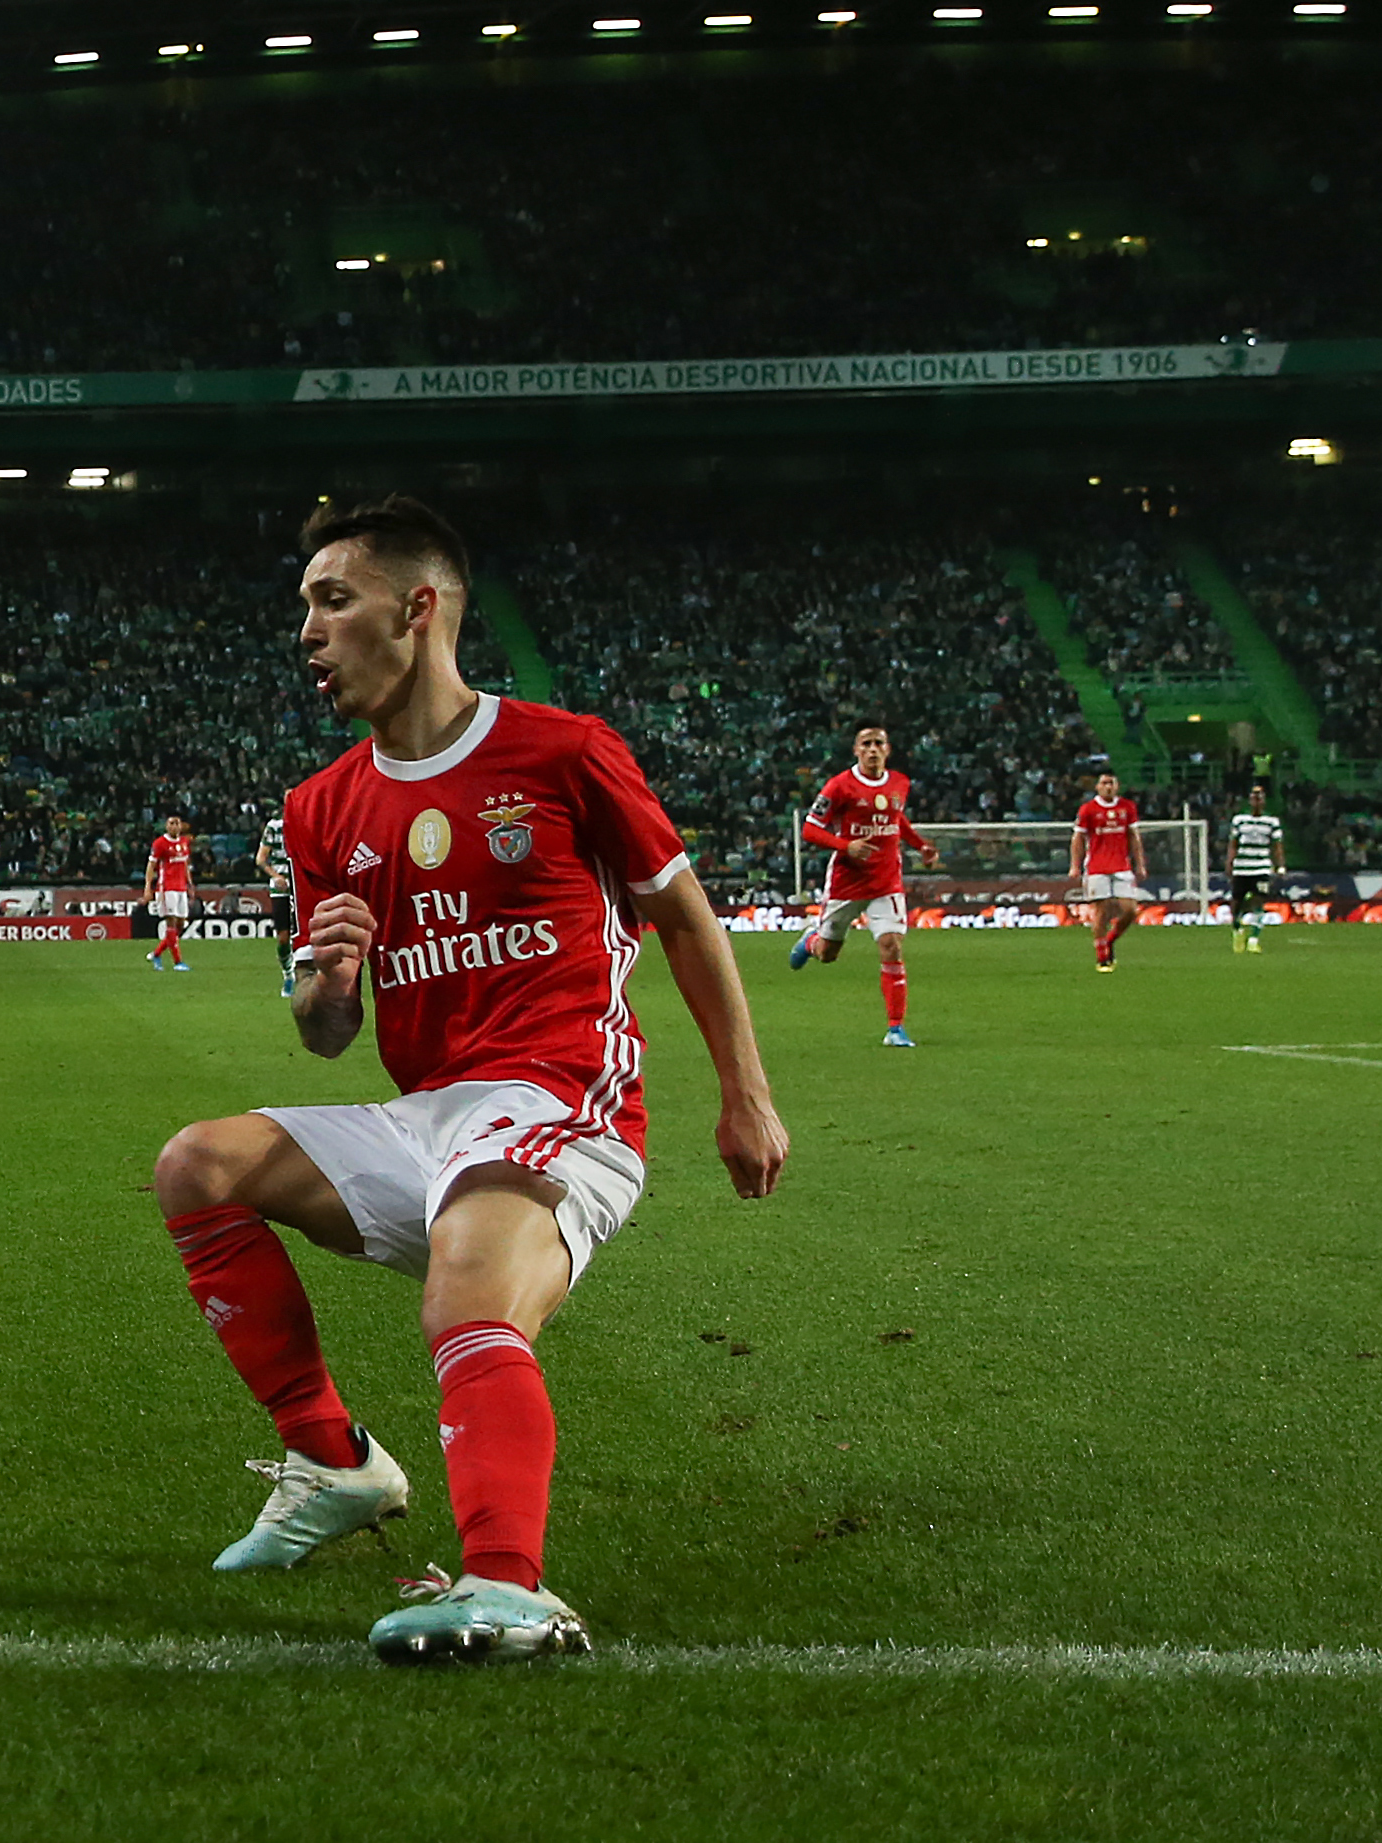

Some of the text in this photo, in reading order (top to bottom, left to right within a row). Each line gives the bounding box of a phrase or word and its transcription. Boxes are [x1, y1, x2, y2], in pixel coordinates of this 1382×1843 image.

[393, 351, 1177, 394] A MAIOR POTÊNCIA DESPORTIVA NACIONAL DESDE 1906
[411, 890, 468, 925] Fly
[21, 925, 72, 941] BOCK
